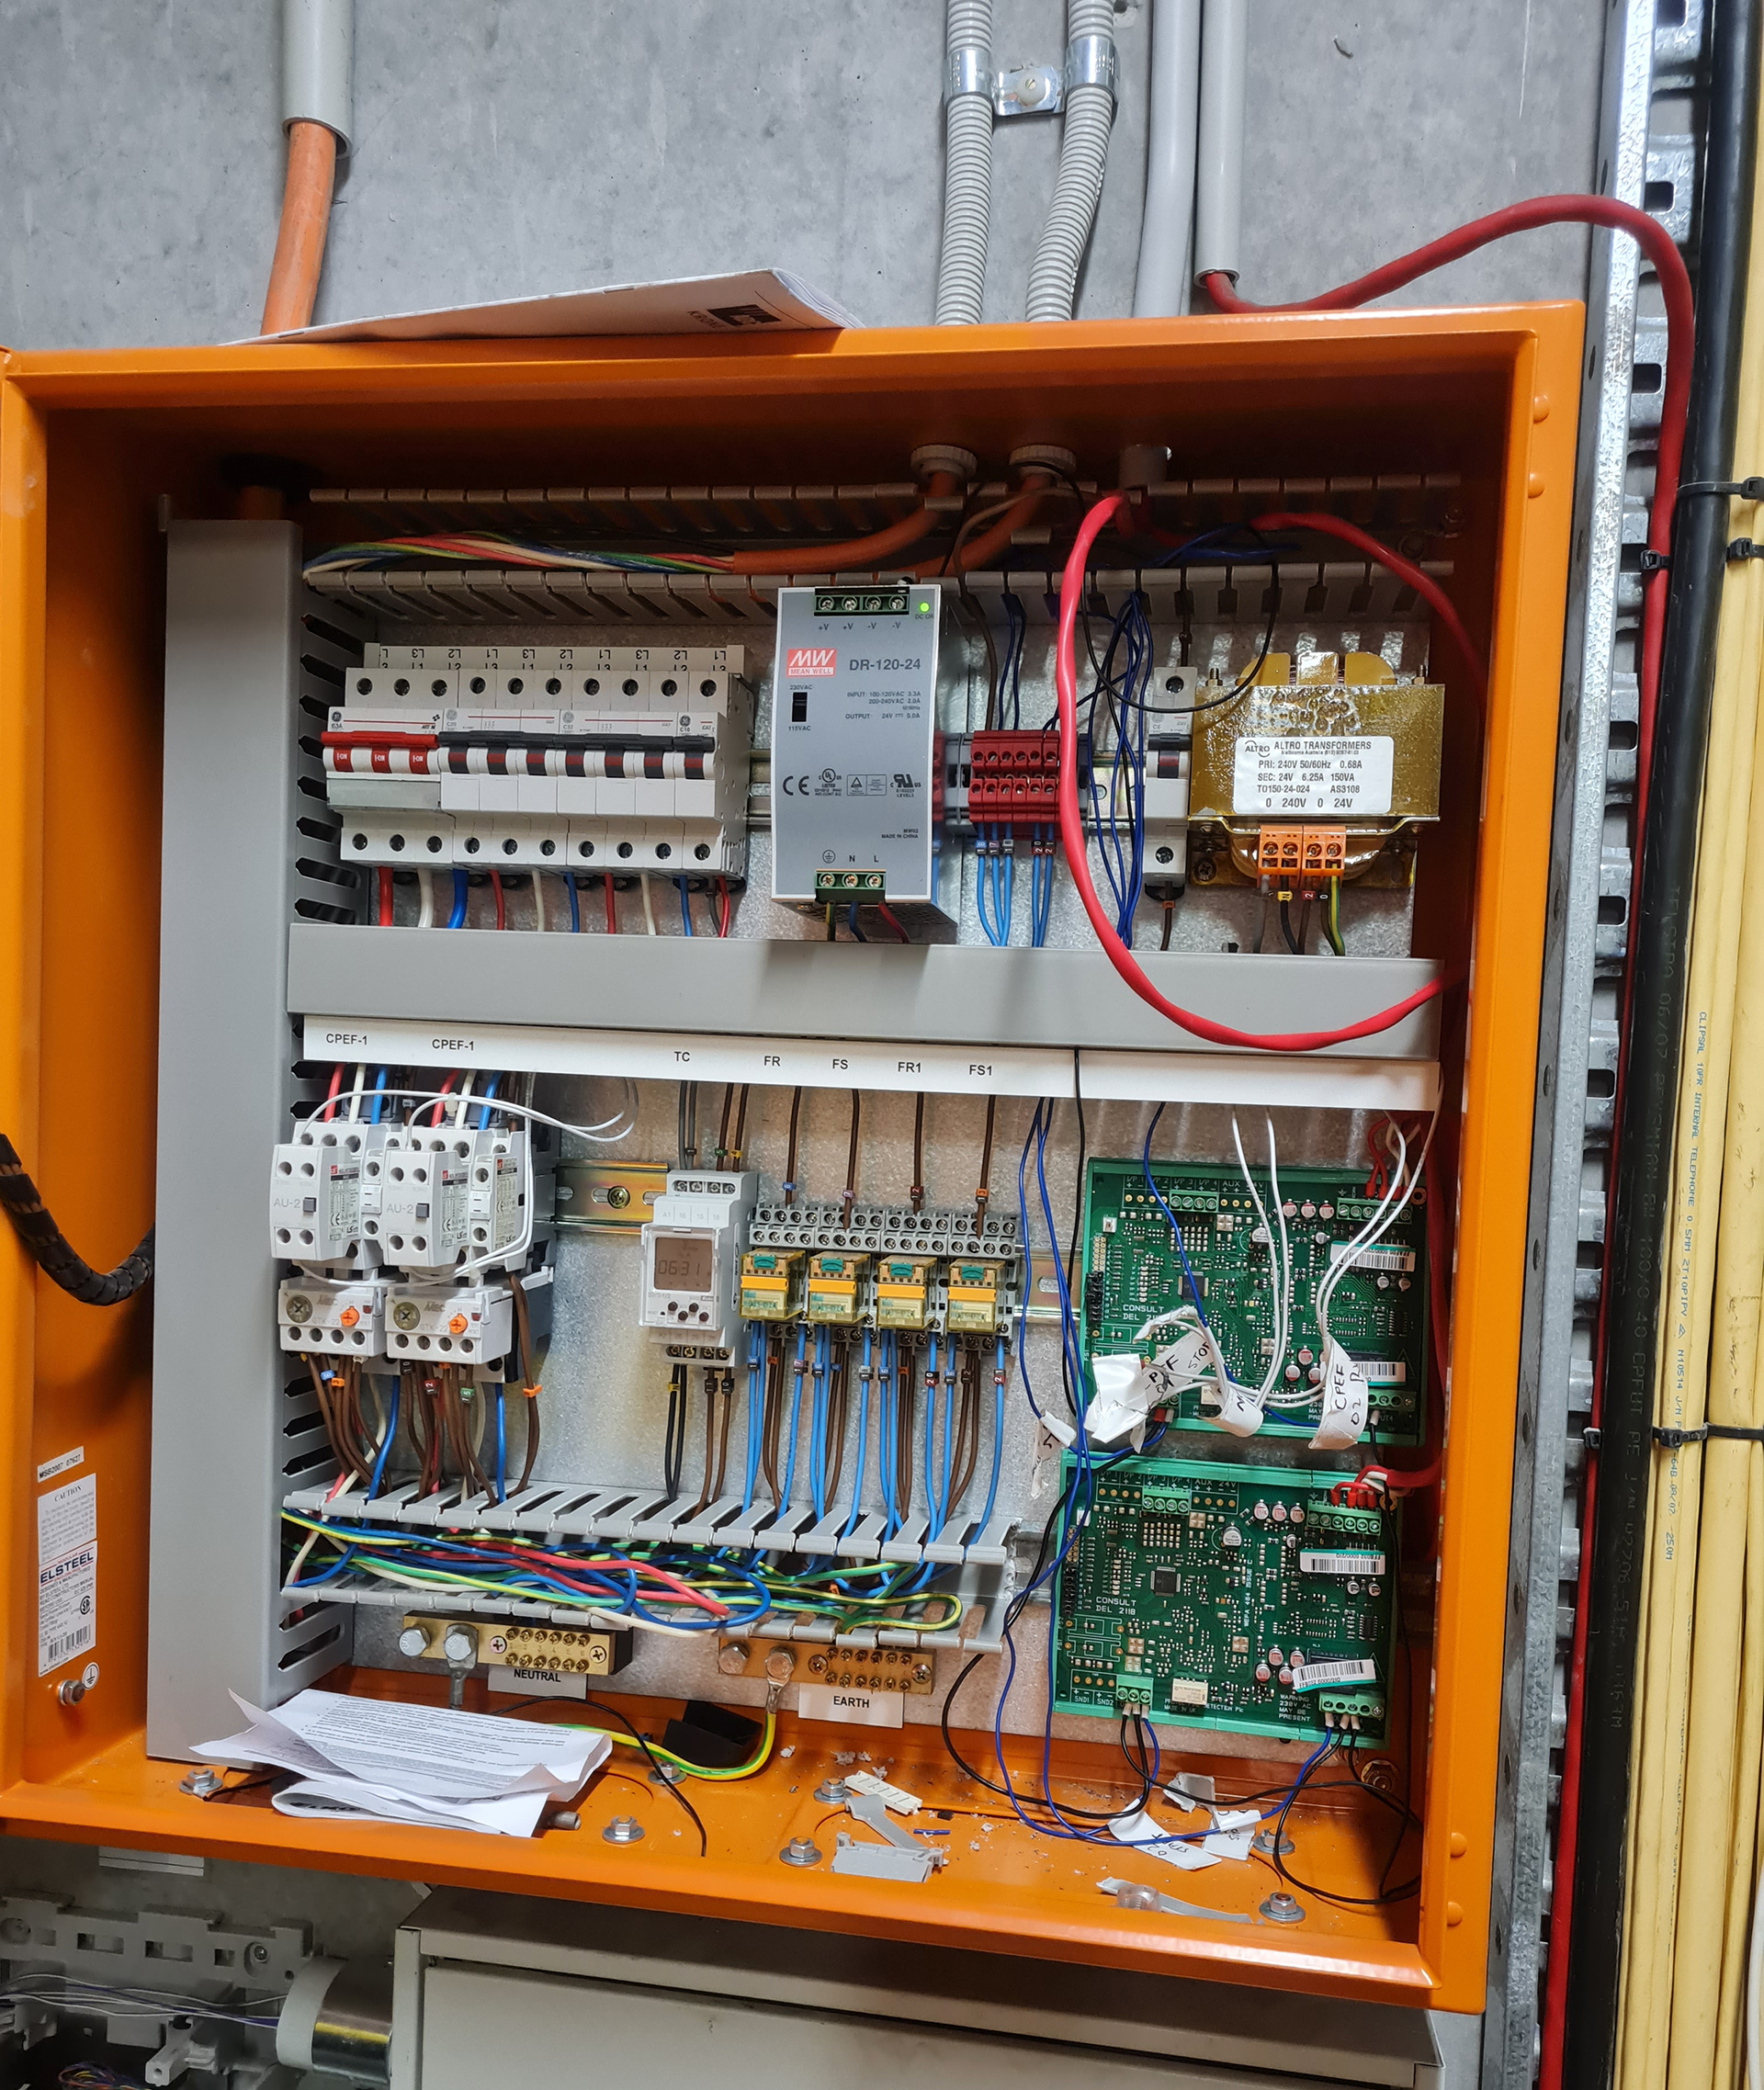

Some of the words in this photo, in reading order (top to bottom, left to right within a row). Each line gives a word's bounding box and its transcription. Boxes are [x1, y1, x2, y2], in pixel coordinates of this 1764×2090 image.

[788, 650, 836, 667] MW
[849, 658, 921, 672] DR-120-24
[1245, 745, 1271, 753] ALTRO
[1273, 740, 1301, 751] ALTRO
[1303, 740, 1372, 751] TRANSFORMERS
[1259, 761, 1276, 770] PRI:
[1277, 761, 1298, 769] 240V
[1299, 760, 1331, 770] 50/60Hz
[1340, 760, 1363, 769] 0.68A
[1258, 774, 1276, 782] SEC:
[1278, 774, 1294, 782] 24V
[1301, 774, 1324, 782] 6.25A
[1330, 773, 1355, 782] 150VA
[1329, 785, 1361, 794] AS3108
[1282, 798, 1306, 808] 240V
[1334, 798, 1353, 808] 24V
[849, 854, 855, 863] N
[874, 854, 879, 863] L
[1654, 992, 1672, 1059] 06/07
[1696, 1011, 1708, 1055] CLIPSAL
[326, 1034, 368, 1045] CPEF-1
[432, 1039, 475, 1051] CPEF-1
[673, 1051, 691, 1062] TC
[763, 1056, 781, 1067] FR
[832, 1058, 849, 1070] FS
[898, 1061, 922, 1073] FR1
[968, 1065, 993, 1077] FS1
[1696, 1062, 1704, 1087] 10PR
[1691, 1092, 1702, 1140] INTERNAL
[1688, 1147, 1699, 1207] TELEPHONE
[274, 1198, 301, 1210] AU-2
[386, 1203, 413, 1214] AU-2
[1123, 1304, 1164, 1313] CONSULT
[1123, 1313, 1140, 1321] DEL
[1676, 1349, 1685, 1390] N10514
[1334, 1364, 1348, 1411] CPEF
[1625, 1430, 1641, 1457] PE
[54, 1485, 83, 1502] CAUTION
[40, 1552, 95, 1585] ELSTEEL
[62, 1565, 91, 1584] MANUFACTURED
[46, 1586, 62, 1599] ELSTEEL
[1095, 1596, 1136, 1607] CONSULT
[1095, 1605, 1113, 1613] DEL
[1118, 1607, 1136, 1615] 2118
[513, 1668, 562, 1684] NEUTRAL
[832, 1694, 870, 1710] EARTH
[1074, 1695, 1090, 1703] SND1
[1097, 1698, 1114, 1706] SND2
[1279, 1694, 1310, 1702] WARNING
[1278, 1713, 1311, 1723] PRESENT
